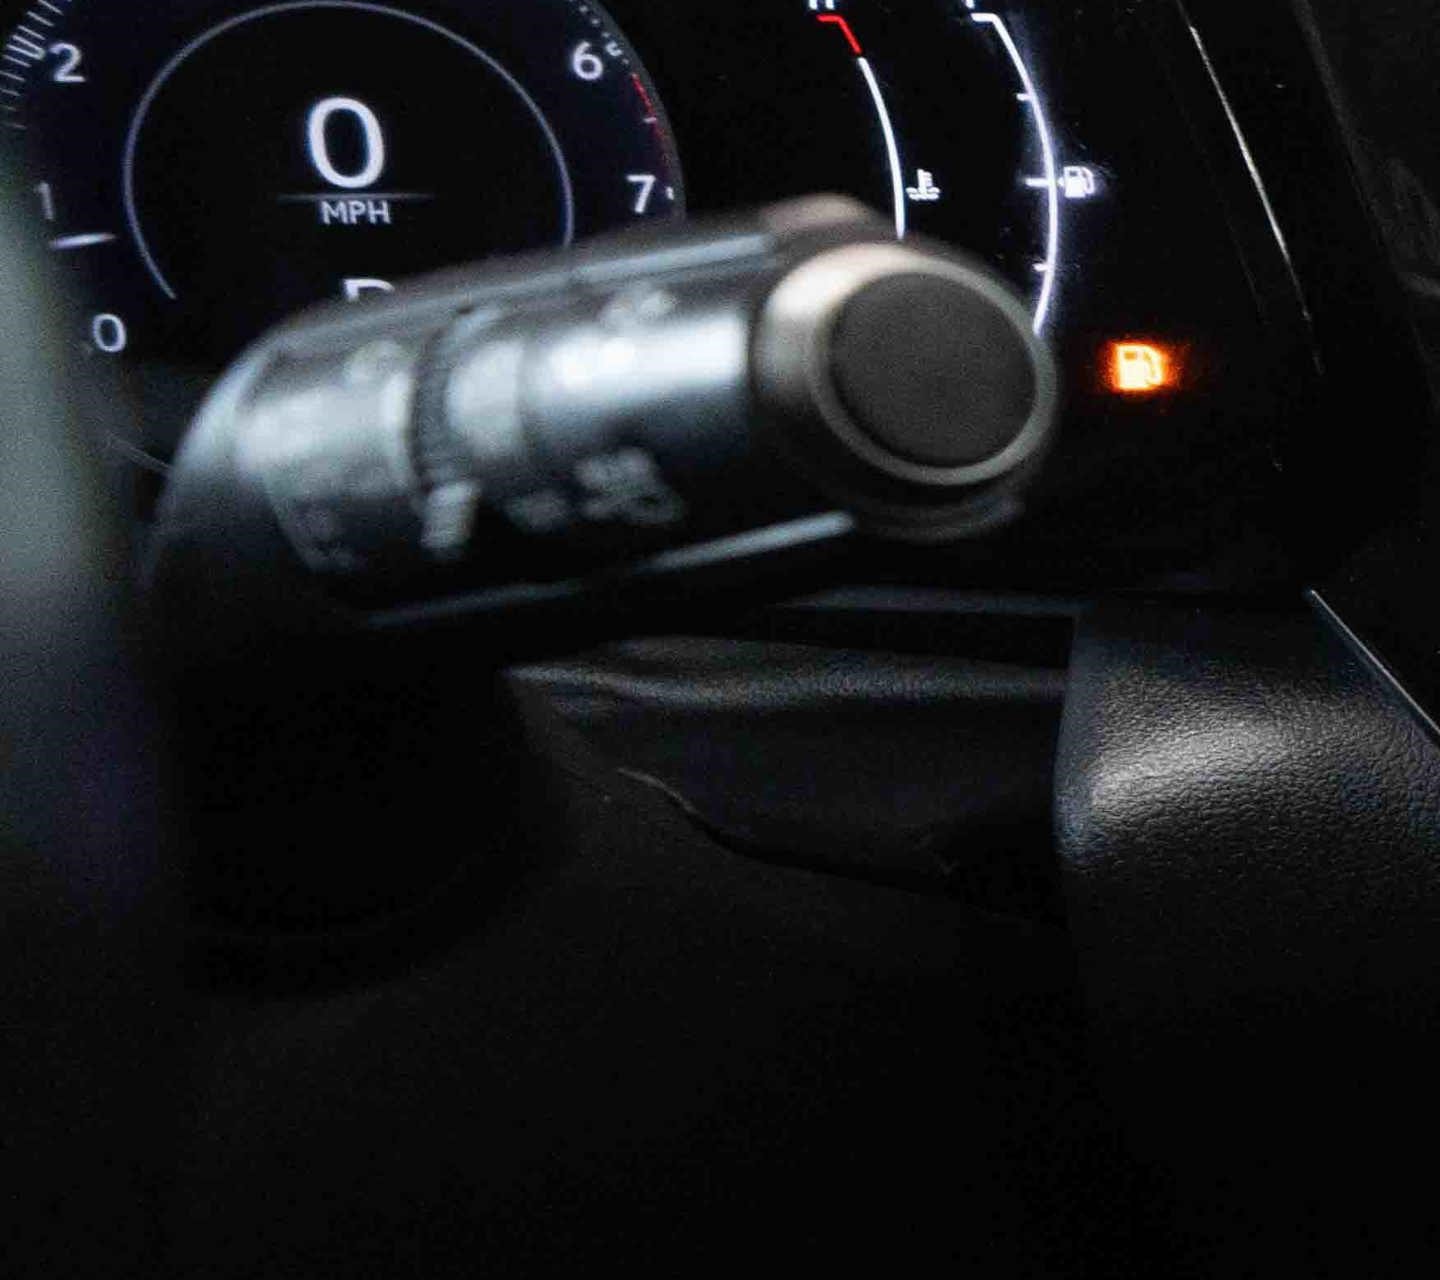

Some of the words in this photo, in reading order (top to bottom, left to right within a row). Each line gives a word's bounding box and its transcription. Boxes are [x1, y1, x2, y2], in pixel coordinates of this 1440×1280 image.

[48, 42, 86, 83] 2
[571, 40, 604, 81] 6
[307, 96, 386, 188] 0
[320, 195, 391, 224] MPH
[627, 173, 656, 213] 7
[93, 313, 126, 352] 0
